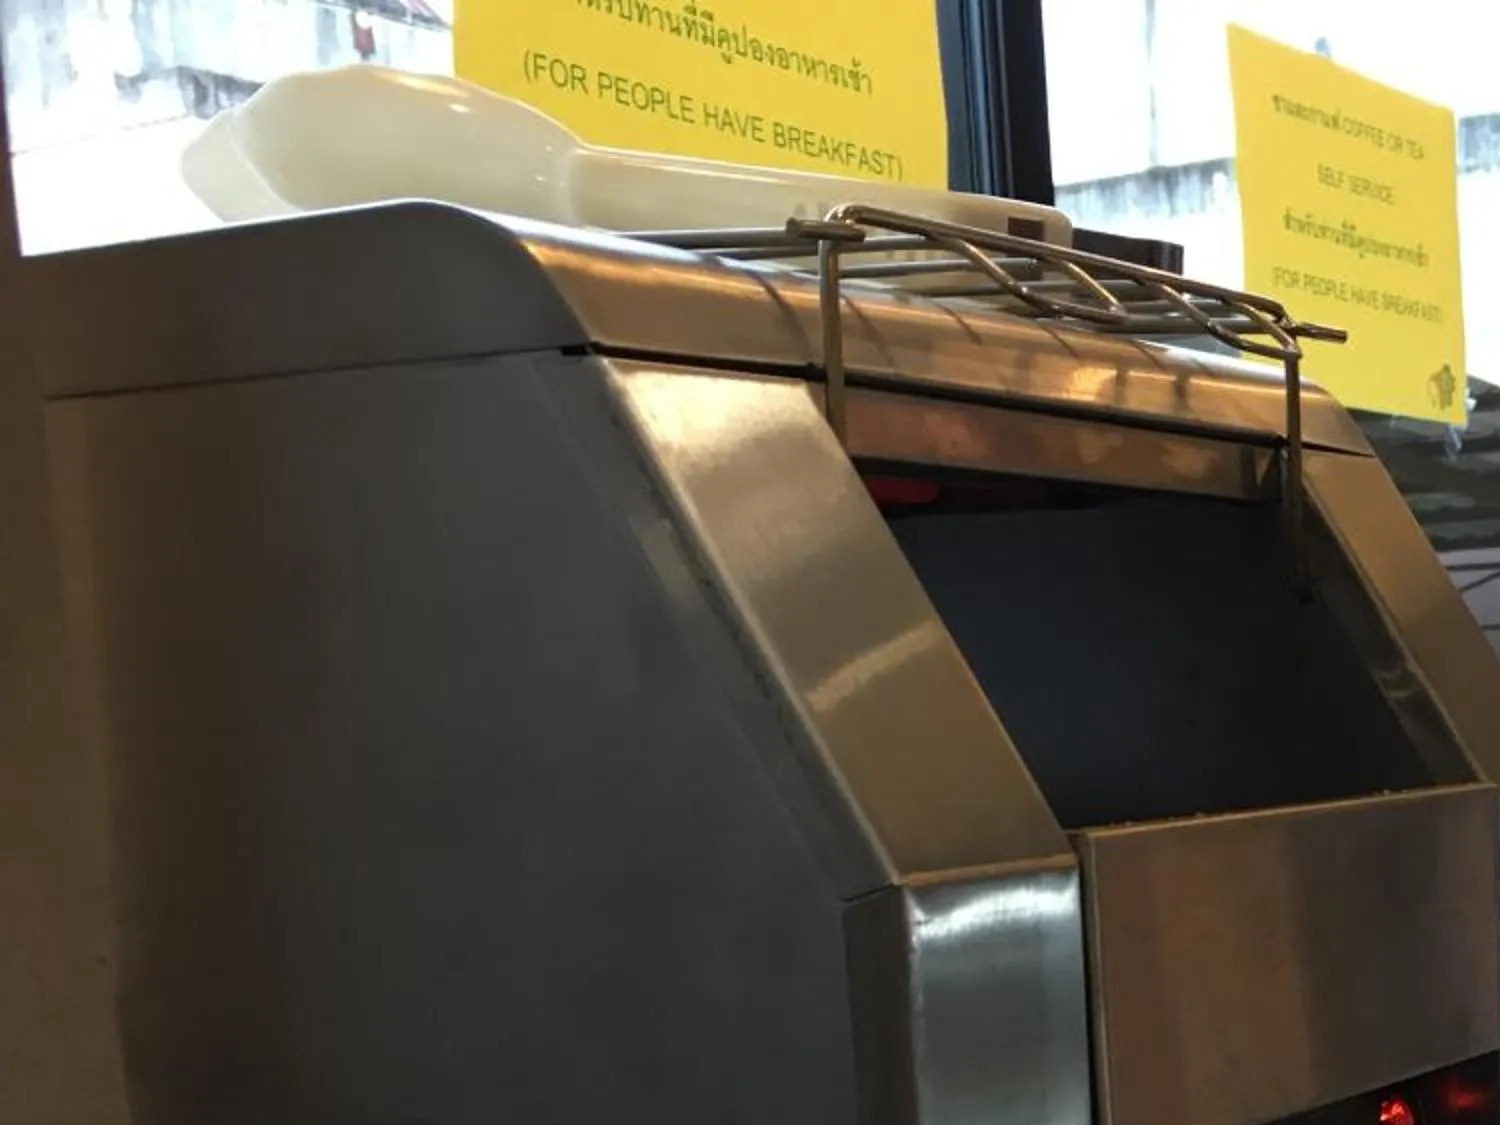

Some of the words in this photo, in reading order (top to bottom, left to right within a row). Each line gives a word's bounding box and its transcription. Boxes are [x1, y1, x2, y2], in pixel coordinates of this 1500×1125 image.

[523, 48, 589, 96] (FOR
[598, 71, 695, 124] PEOPLE
[703, 102, 765, 143] HAVE
[772, 121, 903, 183] BREAKFAST)
[1303, 271, 1350, 303] PEOPLE
